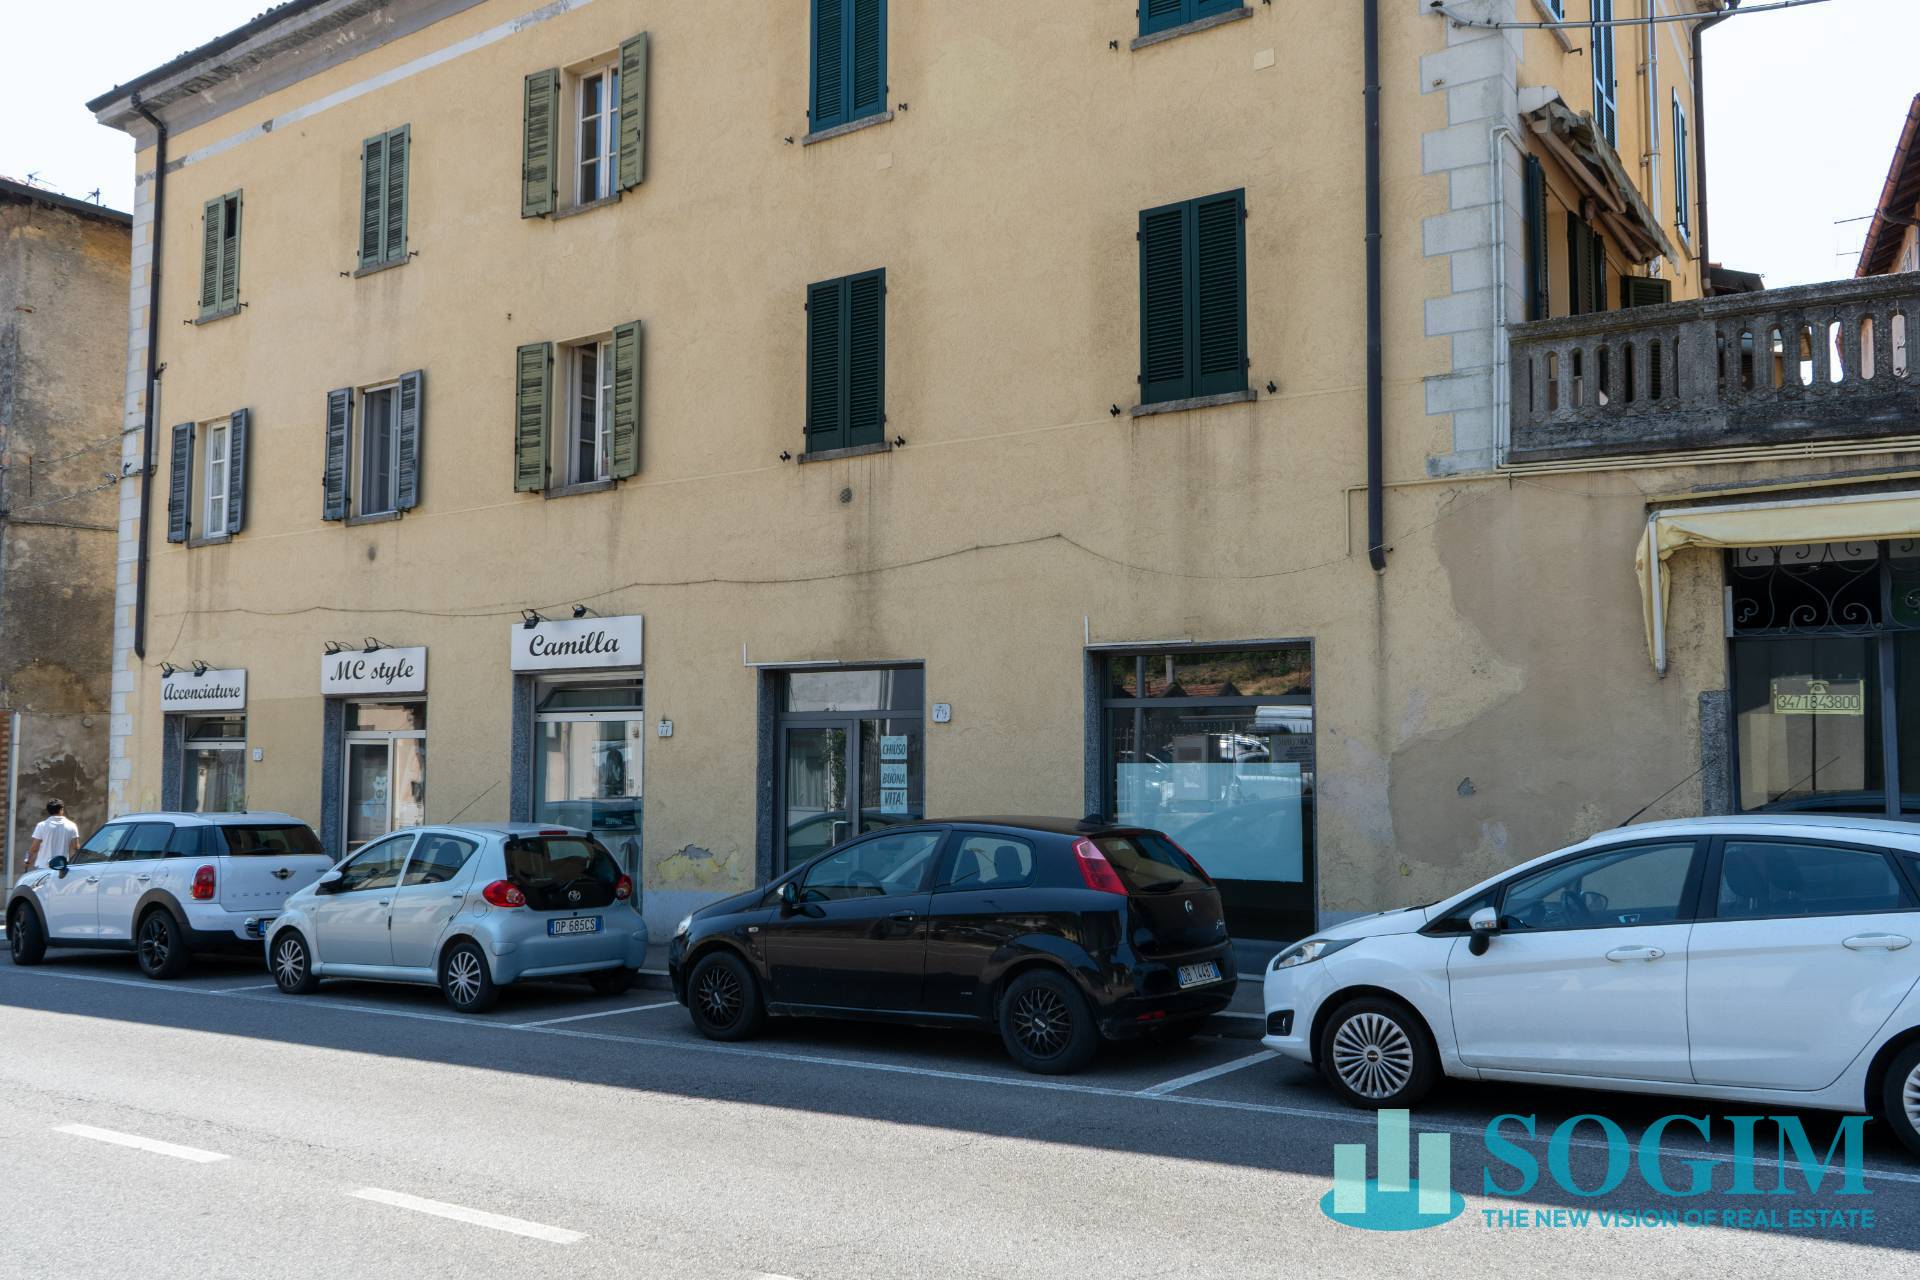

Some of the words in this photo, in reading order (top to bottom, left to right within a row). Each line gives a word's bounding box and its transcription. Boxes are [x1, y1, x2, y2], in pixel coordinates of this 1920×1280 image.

[529, 630, 621, 657] Camilla
[330, 660, 366, 681] MC
[371, 657, 415, 685] style
[163, 682, 241, 701] Acconciature
[882, 743, 906, 755] CHIUSO
[882, 772, 906, 785] BUONA
[555, 921, 567, 934] DP
